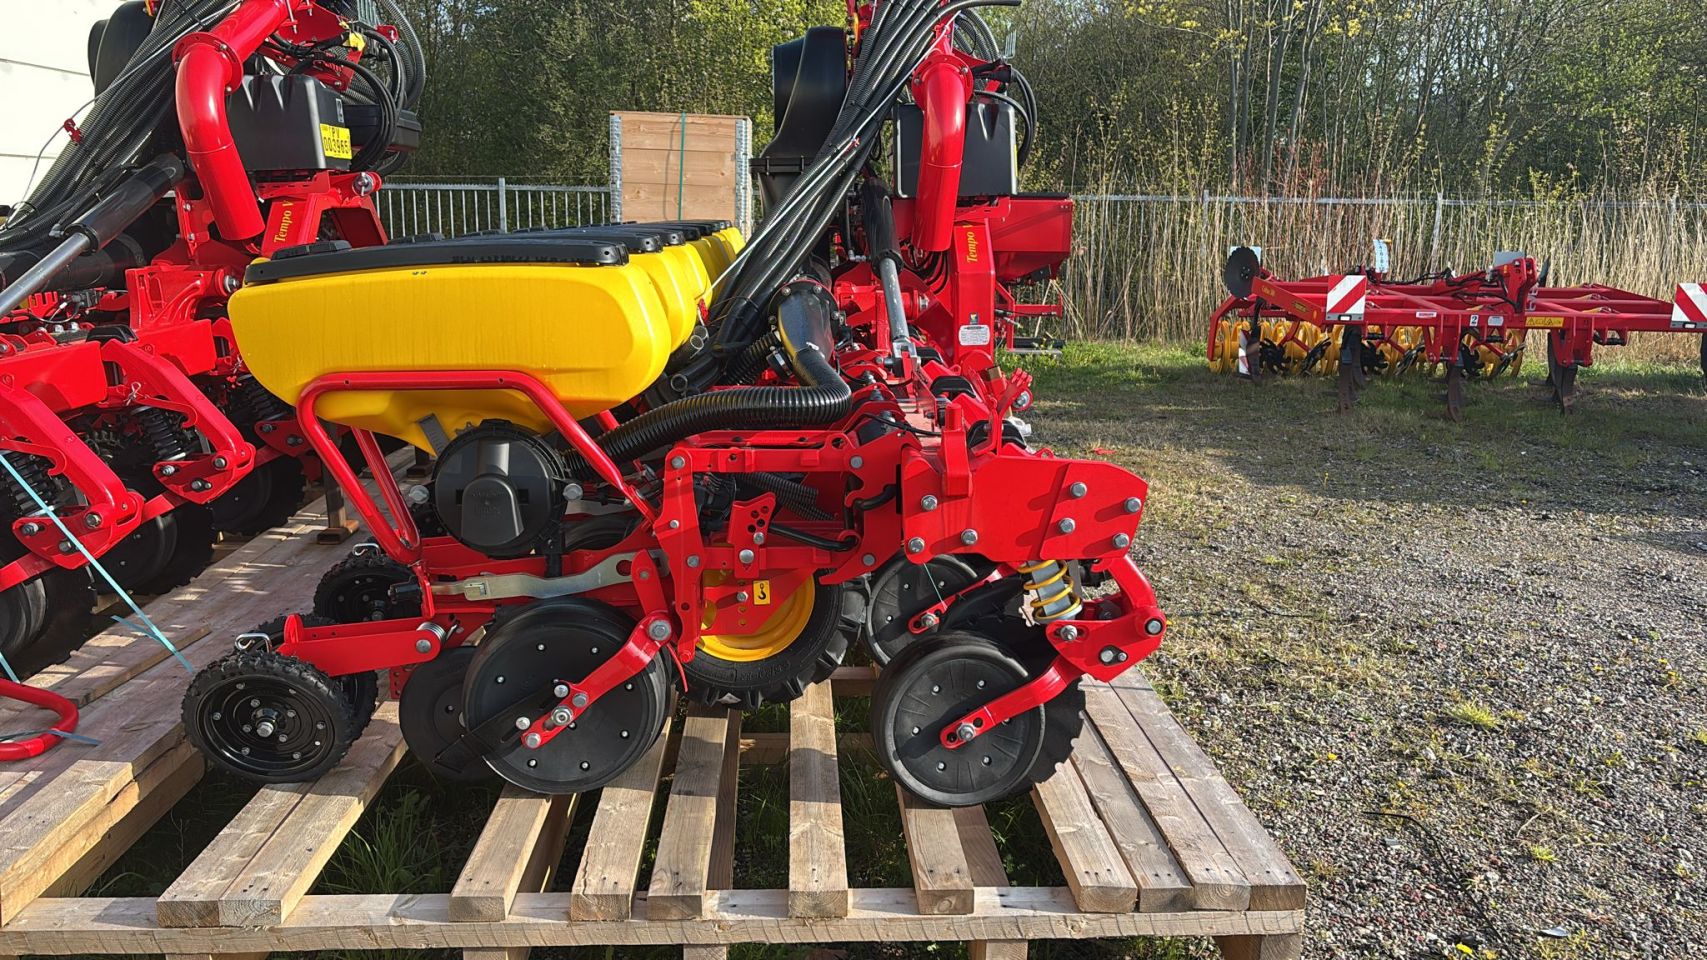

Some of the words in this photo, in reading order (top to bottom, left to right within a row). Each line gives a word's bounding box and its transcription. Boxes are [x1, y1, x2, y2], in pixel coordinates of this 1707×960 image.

[273, 210, 293, 243] Tempo
[966, 231, 979, 263] Tempo
[1471, 315, 1478, 324] 2
